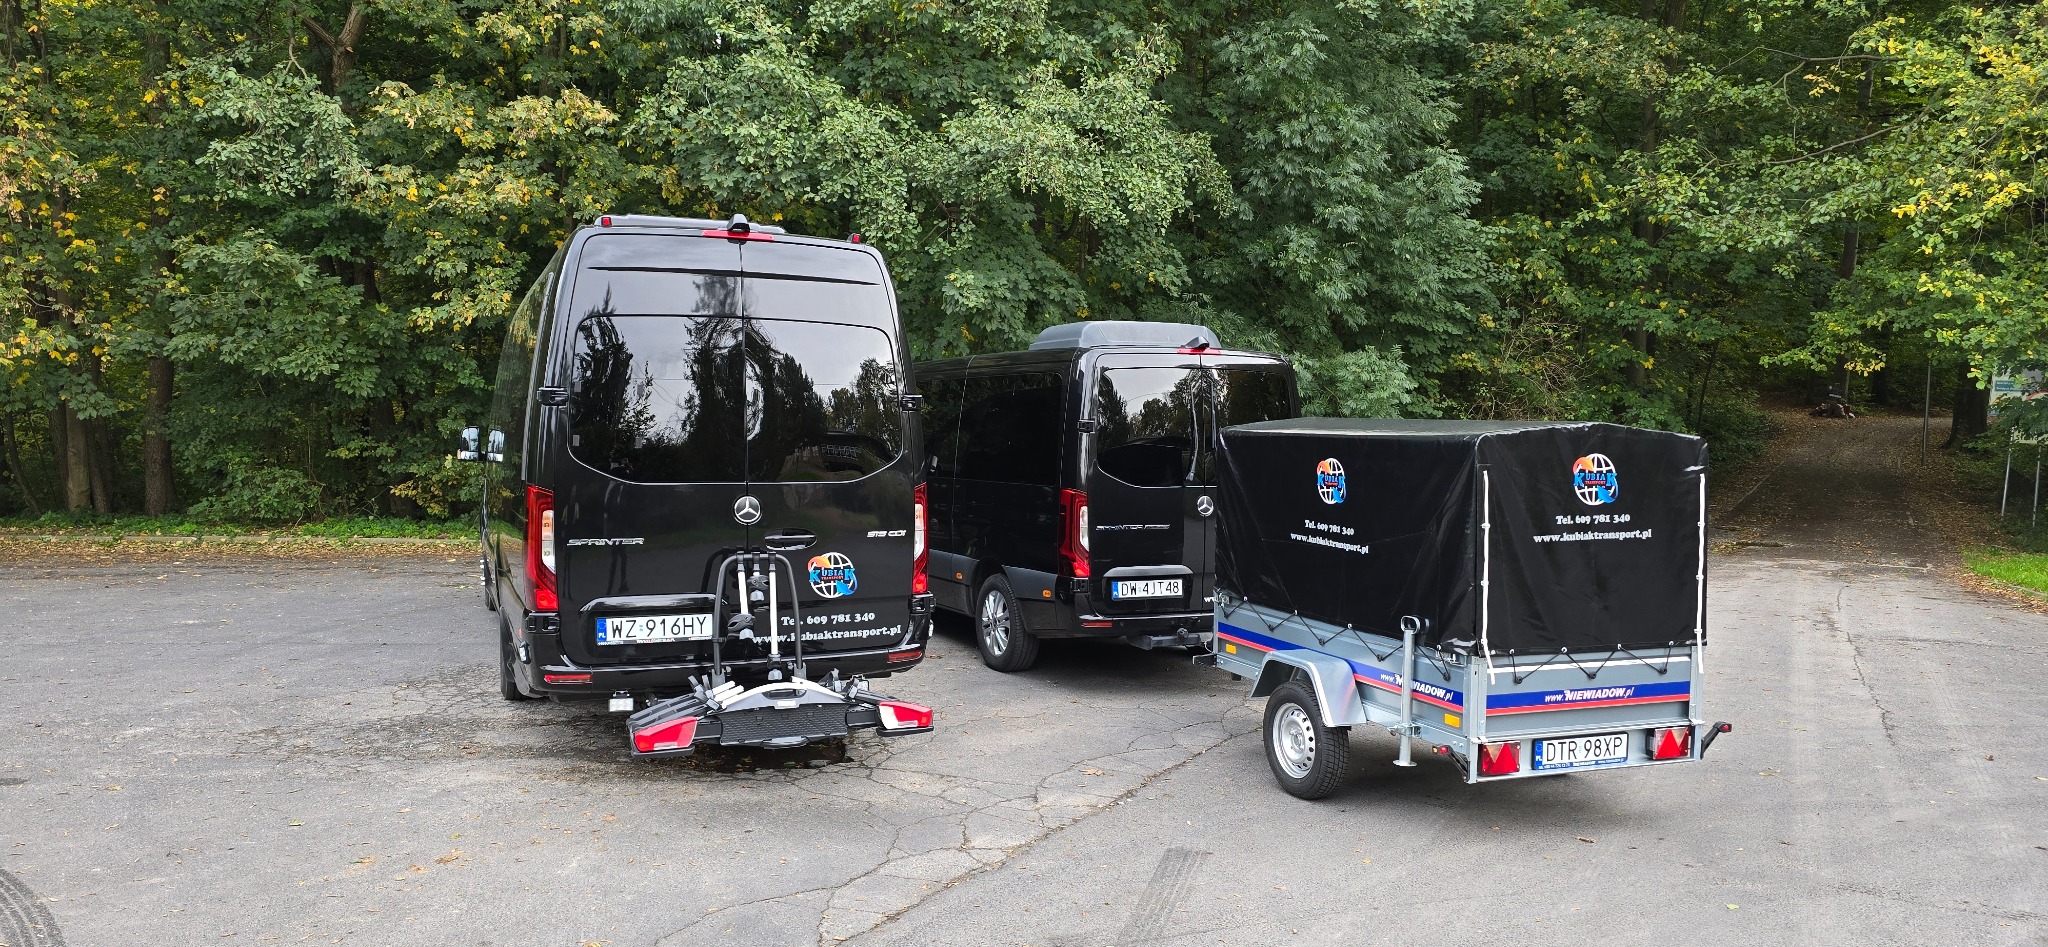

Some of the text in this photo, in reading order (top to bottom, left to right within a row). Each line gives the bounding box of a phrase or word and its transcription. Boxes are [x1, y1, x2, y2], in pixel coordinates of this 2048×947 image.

[1573, 472, 1617, 487] KUBIAK
[1555, 513, 1631, 525] Tel. 609 781 340
[888, 529, 907, 537] CDI
[1304, 519, 1355, 536] Tel. 609 781 340
[566, 537, 645, 546] SPRINTER
[1533, 528, 1652, 543] www.kubiaktransport.pl
[808, 568, 855, 583] KUBIAK
[1121, 581, 1180, 596] DW 4JT48
[780, 612, 876, 626] Te. 609 781 340
[611, 616, 707, 638] WZ 916HY
[1380, 673, 1453, 702] www.NIADOW.pl
[1546, 736, 1623, 762] DTR 98XP
